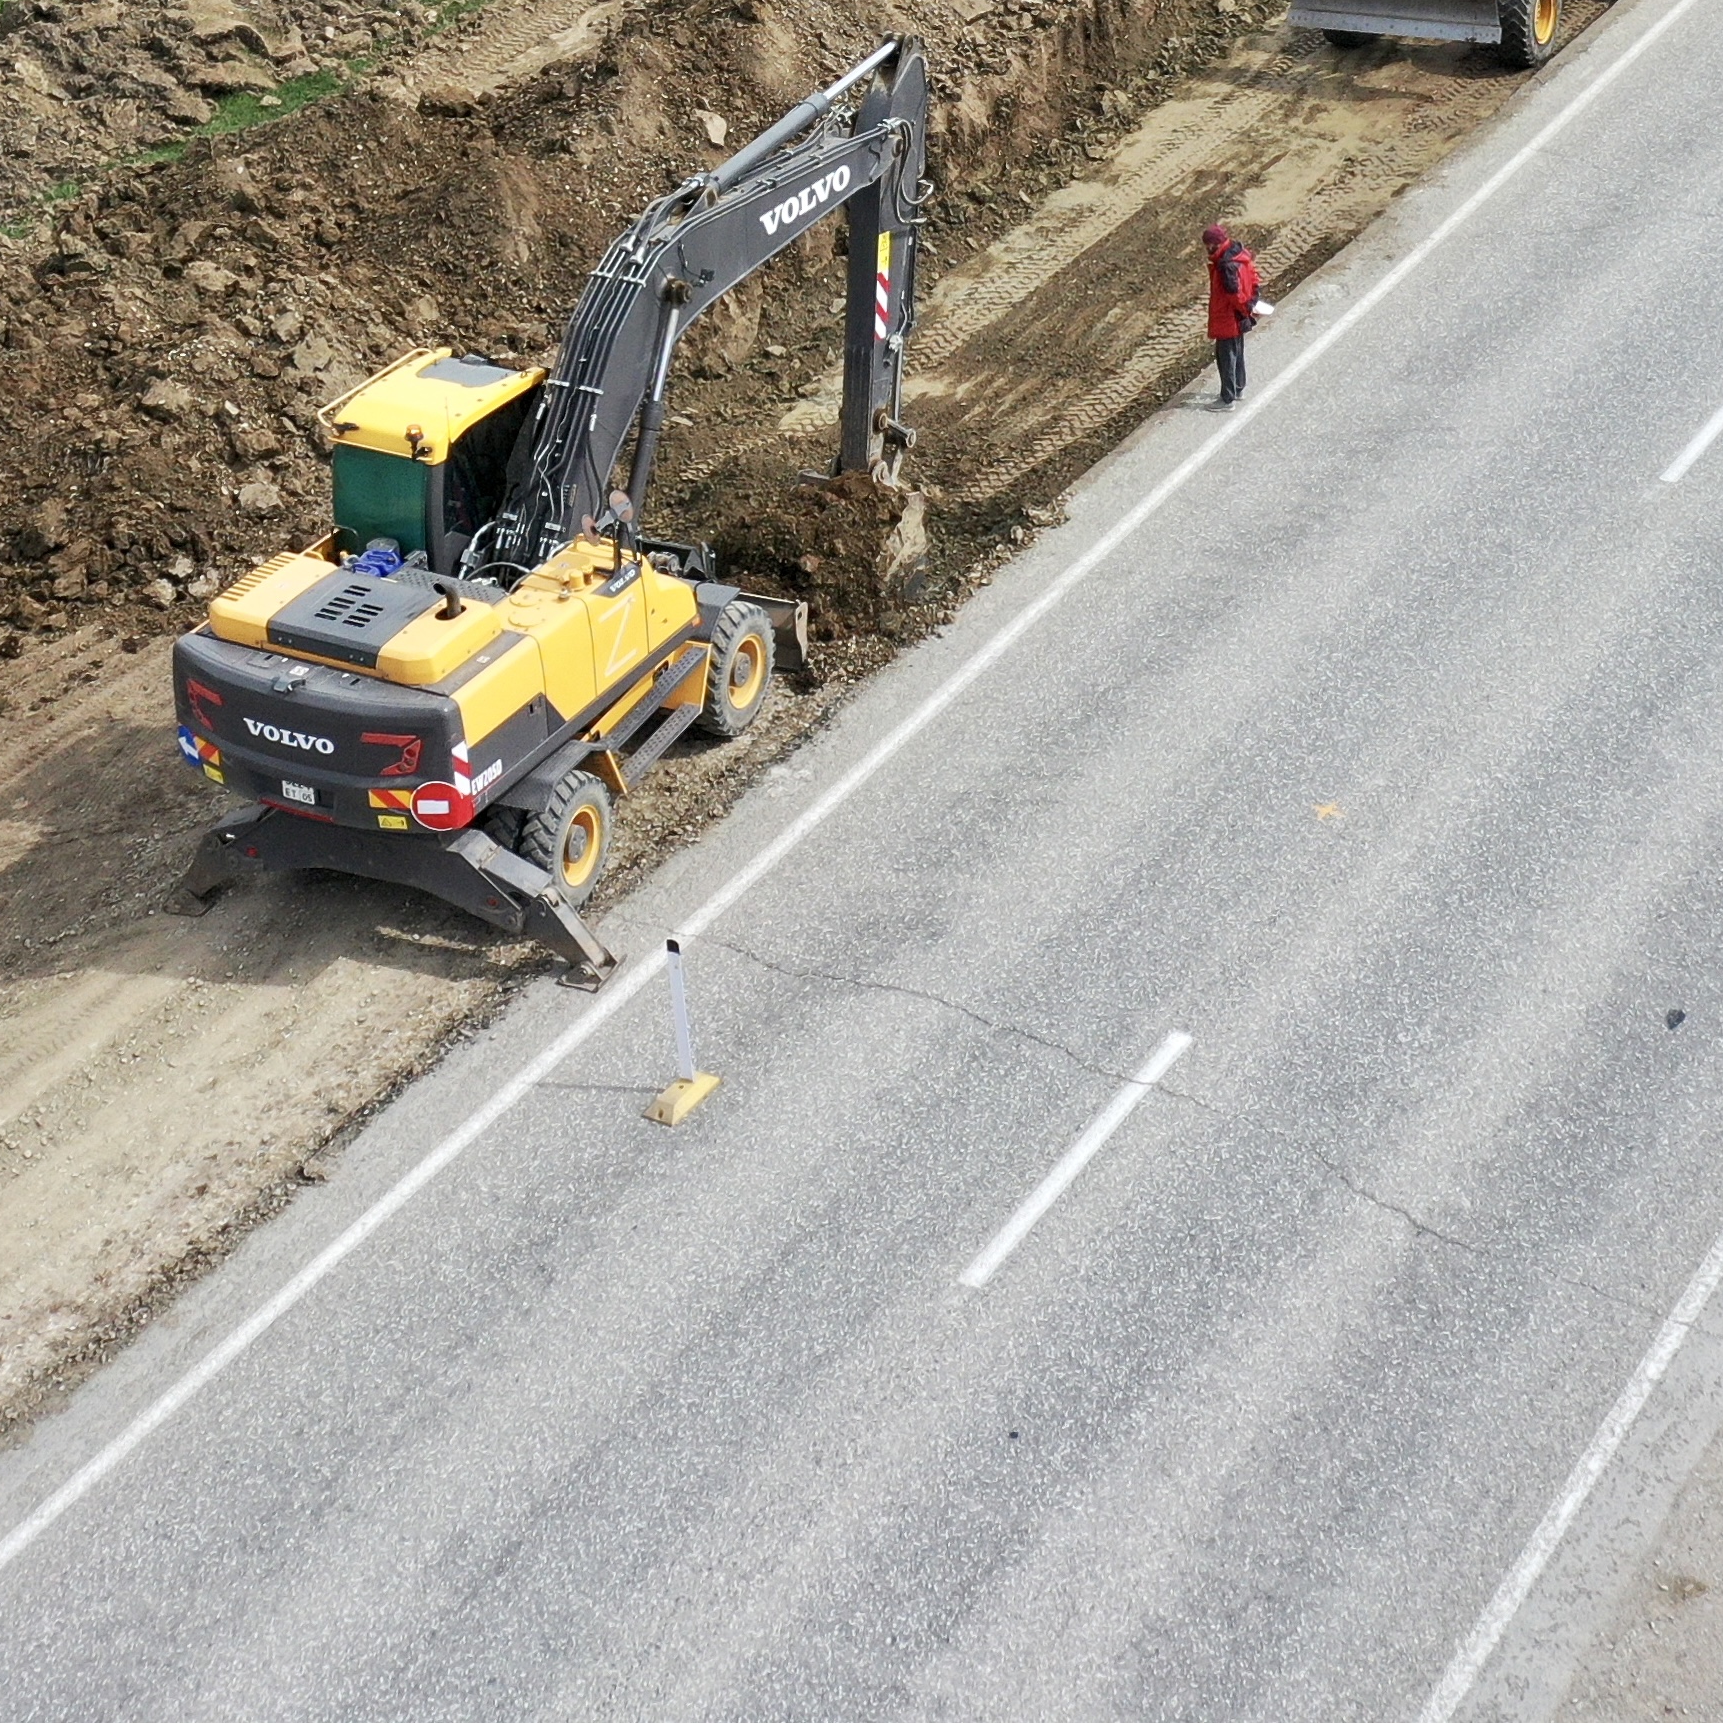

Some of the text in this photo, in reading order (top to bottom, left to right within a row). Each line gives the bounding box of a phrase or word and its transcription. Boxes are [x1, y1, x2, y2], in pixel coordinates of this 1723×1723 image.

[759, 164, 852, 236] VOLVO
[609, 568, 636, 593] VOLVO
[242, 716, 335, 755] VOLVO
